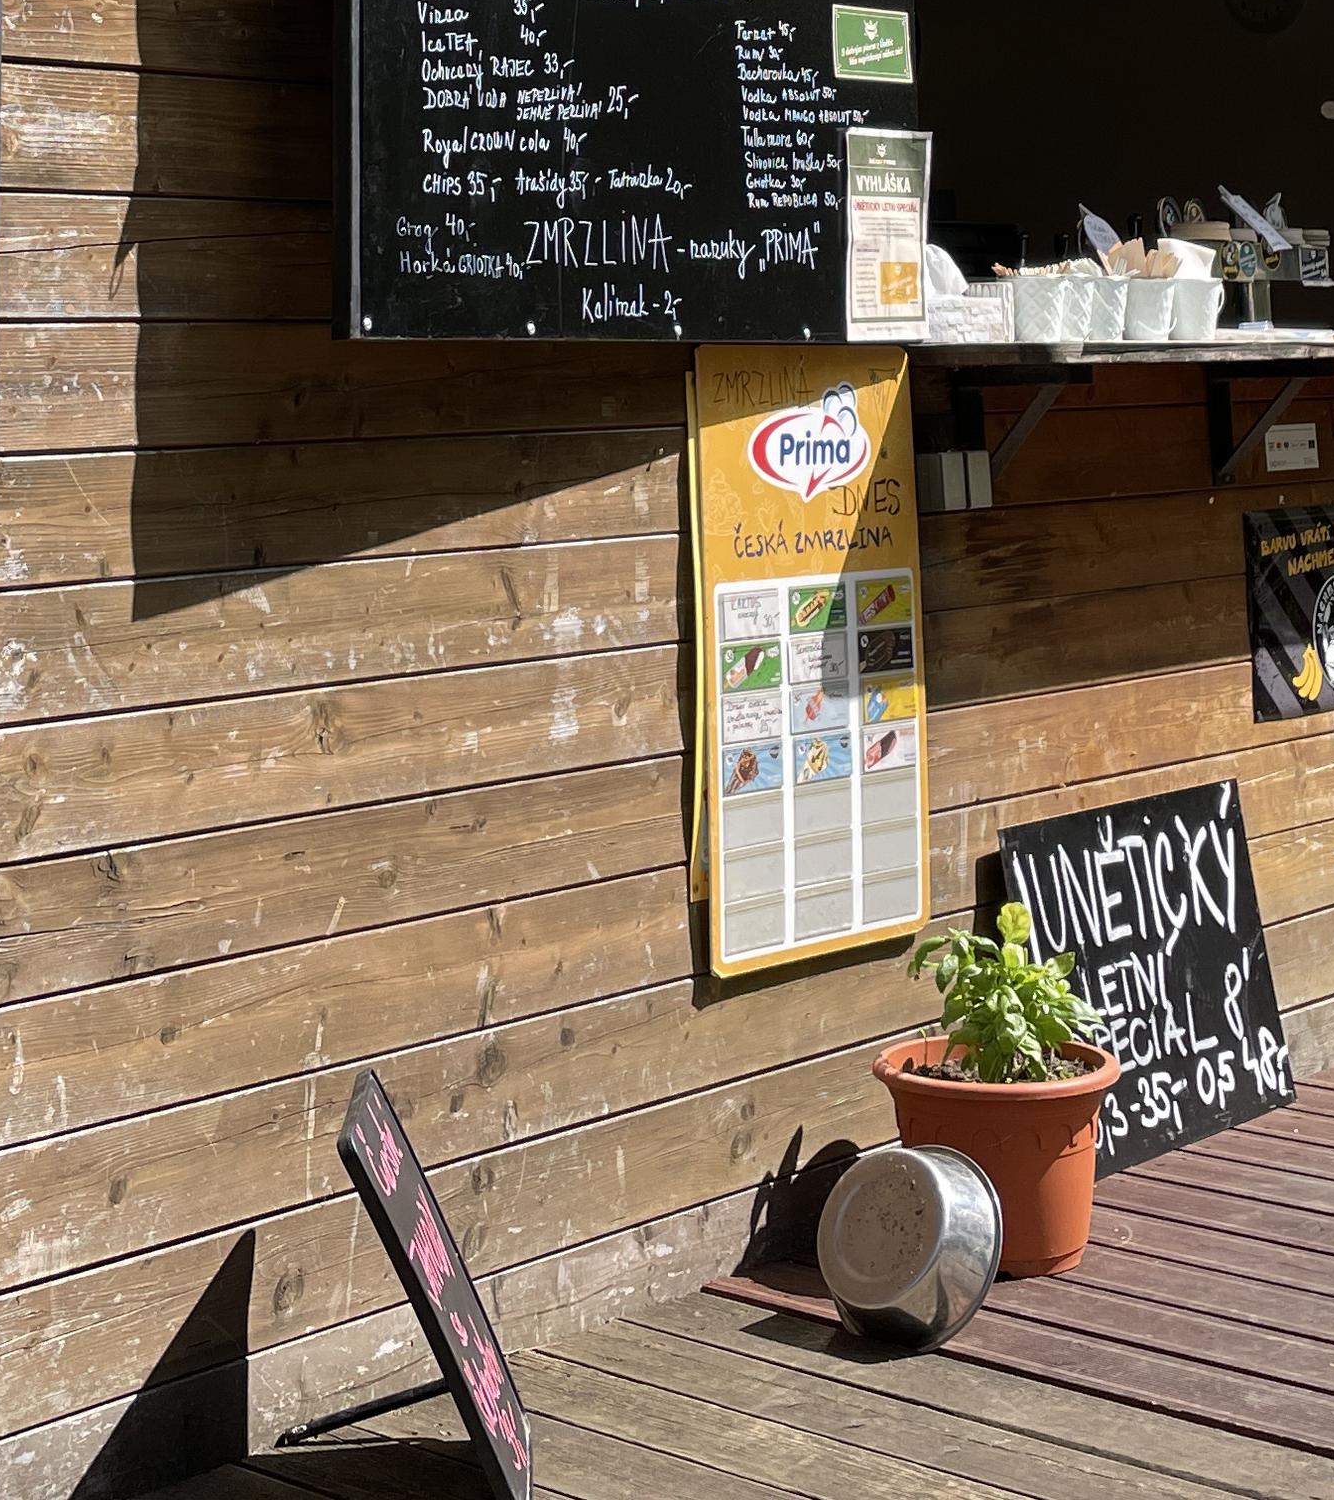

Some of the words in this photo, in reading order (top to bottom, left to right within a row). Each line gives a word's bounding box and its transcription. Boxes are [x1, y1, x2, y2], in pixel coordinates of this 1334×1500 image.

[520, 25, 547, 47] 40,-
[490, 56, 534, 78] RAJEC
[544, 53, 575, 80] 33,-
[422, 84, 472, 110] DOBRÁ
[477, 87, 507, 108] VODA
[607, 86, 639, 119] 25,-
[517, 103, 554, 121] JEMNĚ
[741, 85, 777, 104] Vodka
[742, 105, 780, 122] Vodka
[422, 126, 467, 169] Royal
[470, 130, 515, 150] CROWN
[520, 129, 550, 151] cola
[563, 128, 588, 155] 40,-
[515, 164, 566, 208] Arašídy
[665, 168, 693, 199] 20,-
[856, 172, 911, 193] VYHLÁŠKA
[396, 216, 439, 254] Grog
[524, 209, 672, 273] ZMRZLINA
[690, 229, 756, 279] nanuky
[400, 248, 455, 276] Horká
[779, 430, 851, 466] Prima
[828, 478, 901, 516] DNES
[733, 520, 789, 558] ČESKÁ
[794, 525, 893, 554] ZMRZLINA
[1260, 533, 1297, 556] BARVU
[1300, 521, 1331, 546] VRÁTÍ
[1197, 1051, 1235, 1109] 0,5
